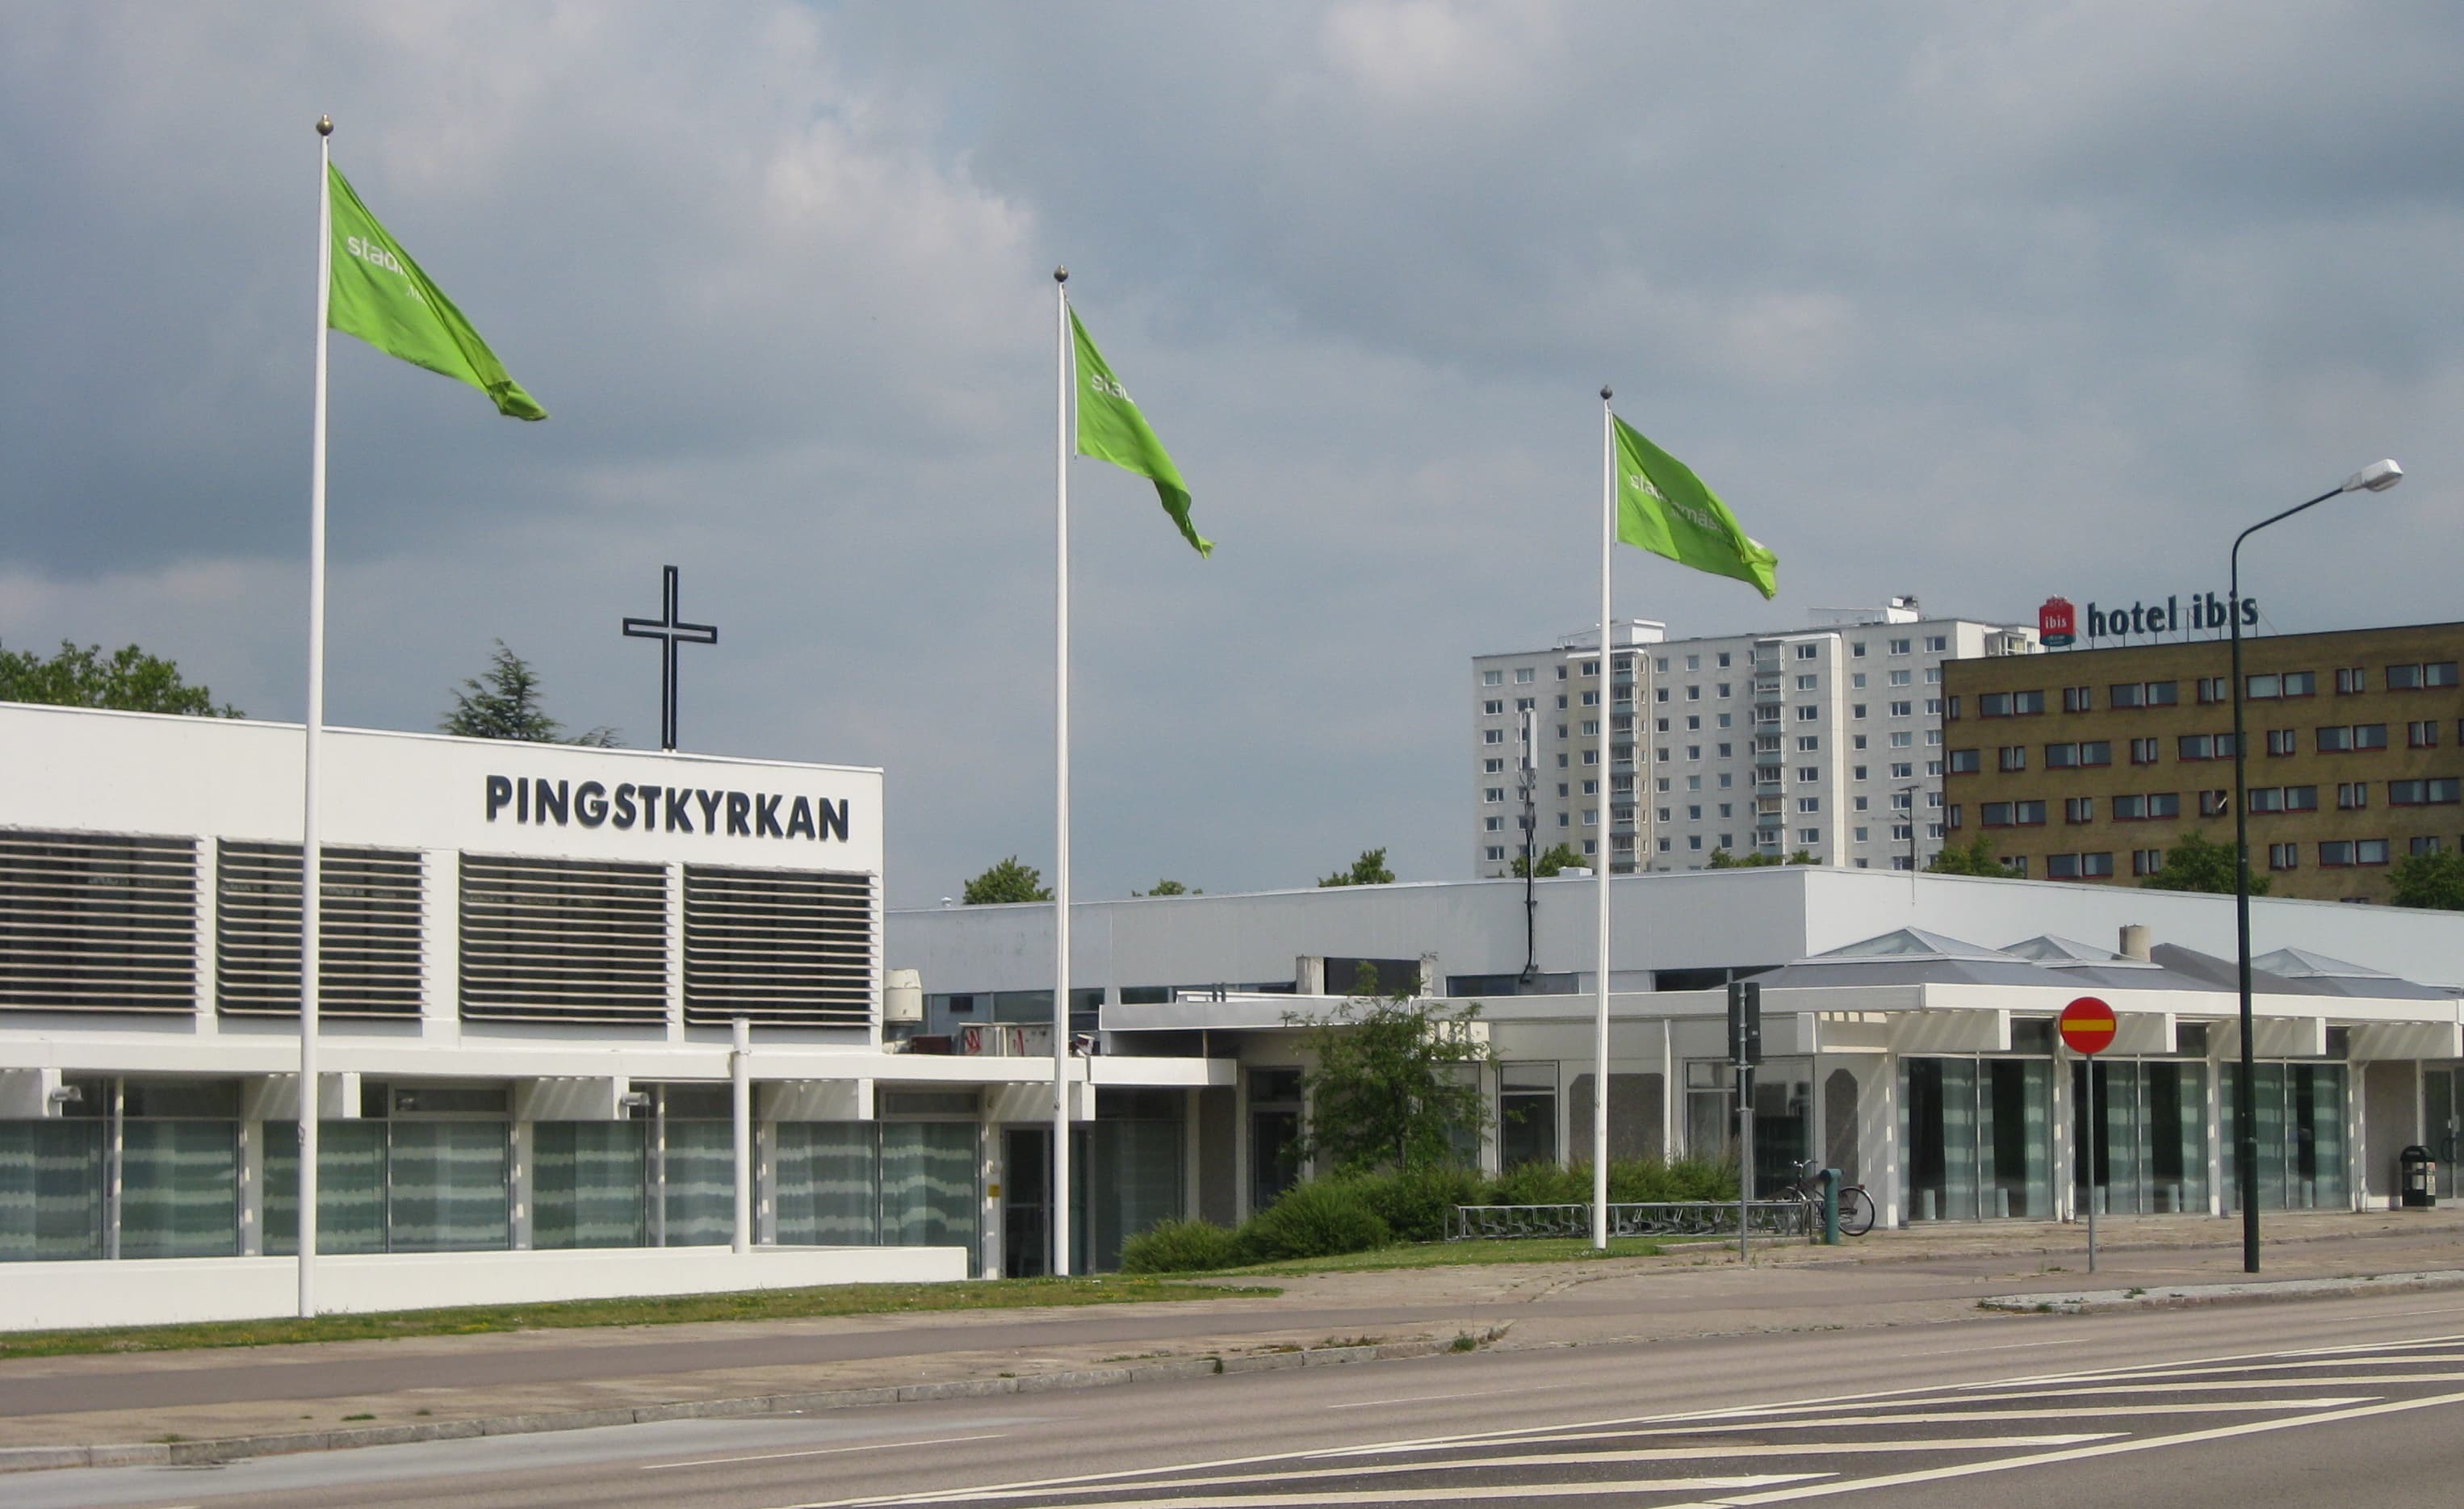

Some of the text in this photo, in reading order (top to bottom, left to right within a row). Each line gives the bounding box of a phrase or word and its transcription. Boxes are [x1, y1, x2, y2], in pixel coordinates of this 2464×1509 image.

[2045, 614, 2067, 629] ibis
[2087, 594, 2177, 638] hotel
[486, 773, 849, 842] PINGSTKYRKAN
